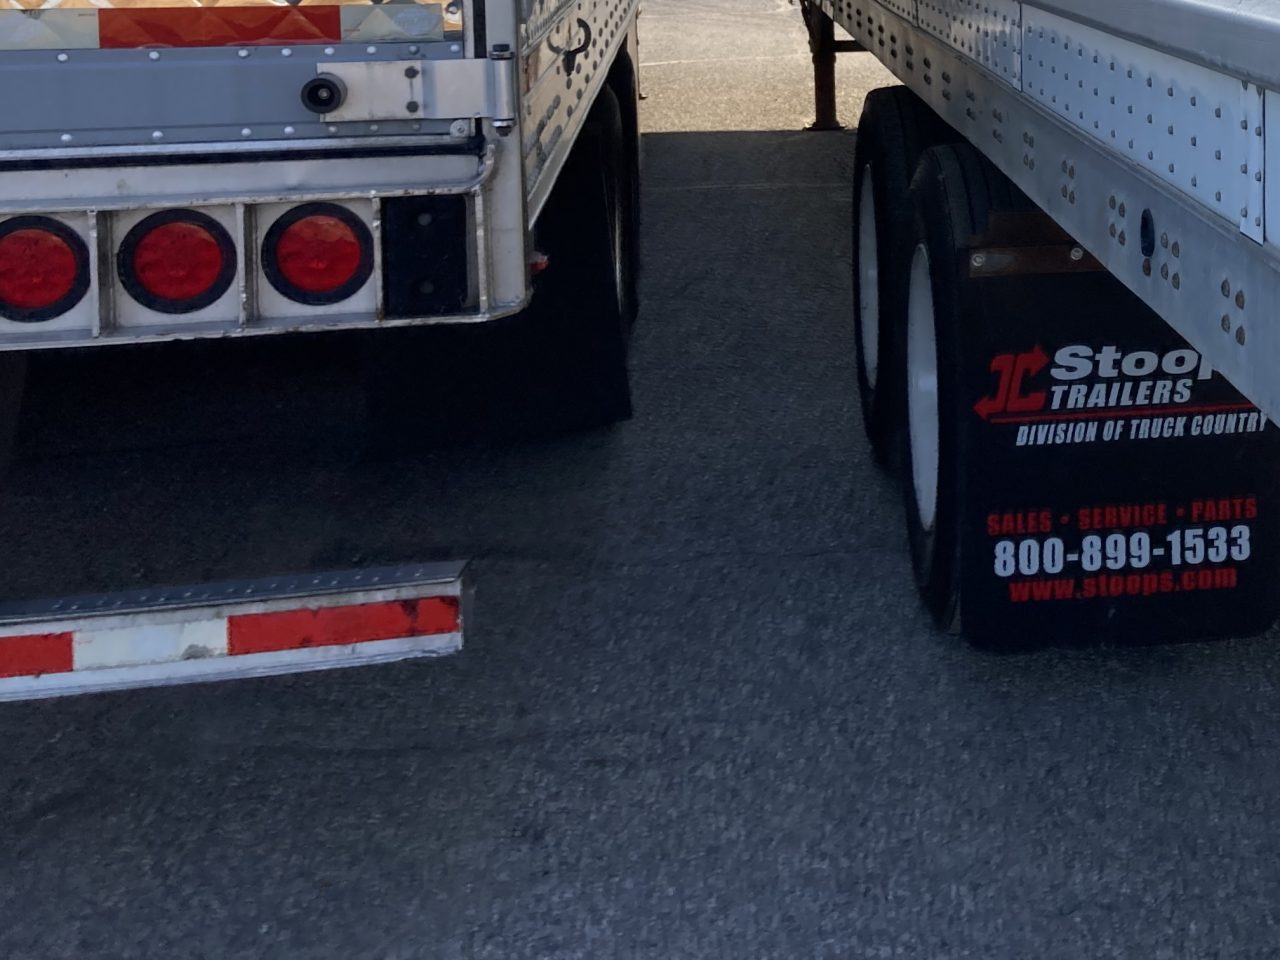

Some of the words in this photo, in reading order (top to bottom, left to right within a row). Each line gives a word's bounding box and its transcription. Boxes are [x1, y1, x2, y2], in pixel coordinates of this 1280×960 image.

[1050, 379, 1194, 410] TRAILERS
[1016, 420, 1098, 446] DIVISION
[1102, 419, 1124, 441] OF
[1129, 416, 1187, 439] TRUCK
[1191, 412, 1269, 436] COUNTRY
[987, 511, 1053, 536] SALES
[1078, 504, 1167, 530] SERVICE
[1191, 497, 1258, 522] PARTS
[993, 525, 1251, 577] 800-899-1533
[1009, 567, 1238, 603] www.stoops.com
